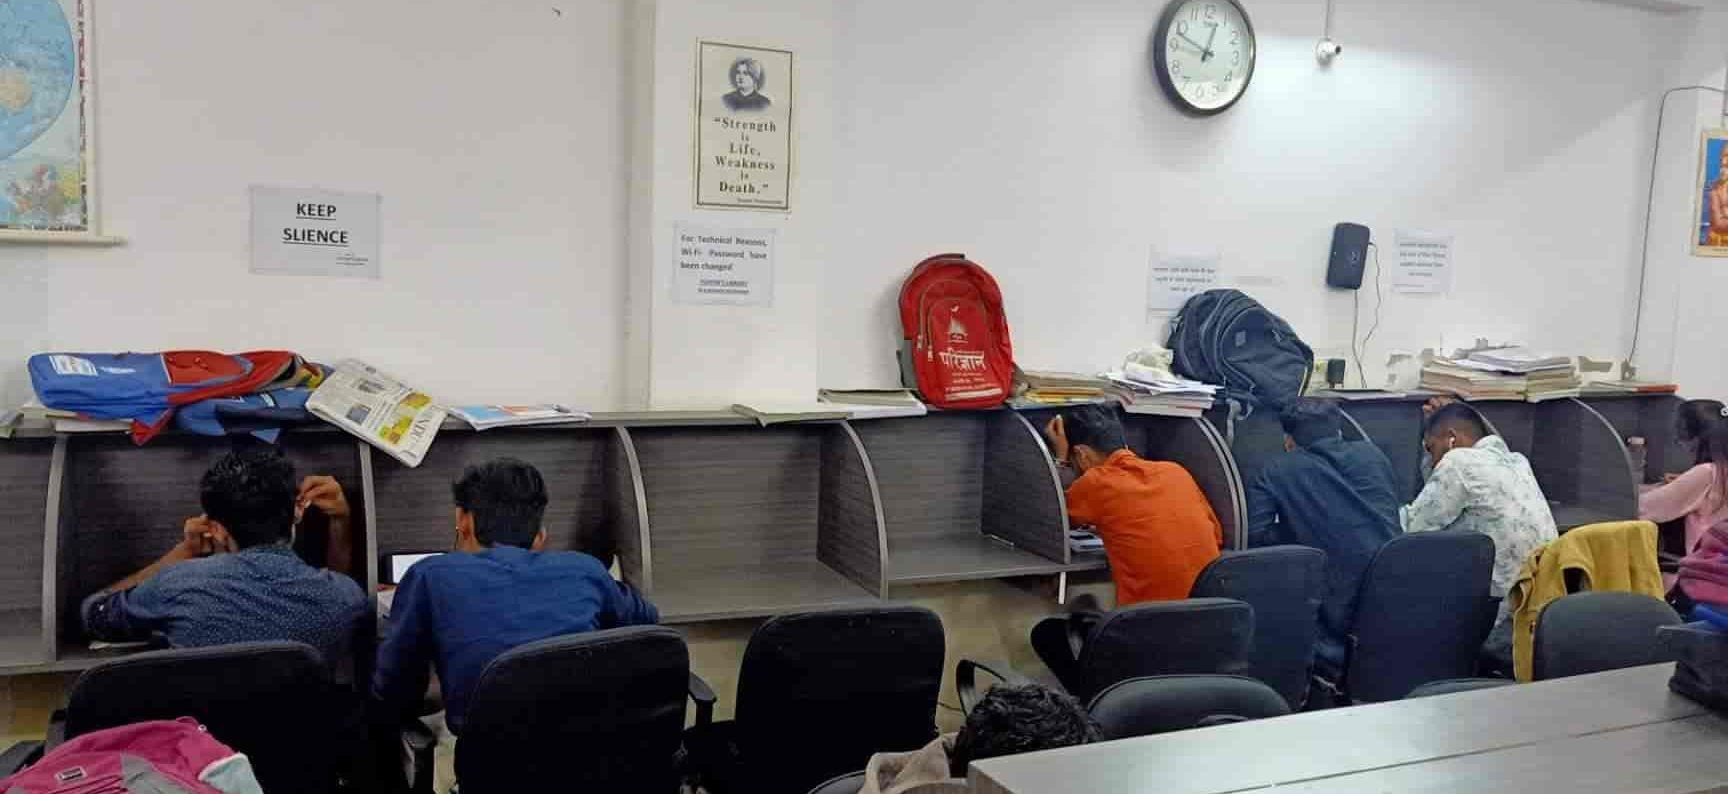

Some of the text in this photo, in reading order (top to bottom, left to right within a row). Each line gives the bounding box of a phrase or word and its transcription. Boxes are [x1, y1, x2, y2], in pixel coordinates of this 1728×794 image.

[1204, 3, 1217, 20] 12
[1168, 36, 1179, 53] 9
[1229, 27, 1241, 46] 2
[1231, 49, 1240, 67] 3
[1171, 58, 1180, 75] 8
[1223, 69, 1233, 82] 4
[714, 155, 776, 171] Weakness
[296, 203, 337, 217] KEEP
[282, 227, 350, 244] SLIENCE
[697, 235, 733, 244] Technical
[709, 249, 745, 259] Password
[749, 251, 767, 260] have
[680, 261, 700, 269] been
